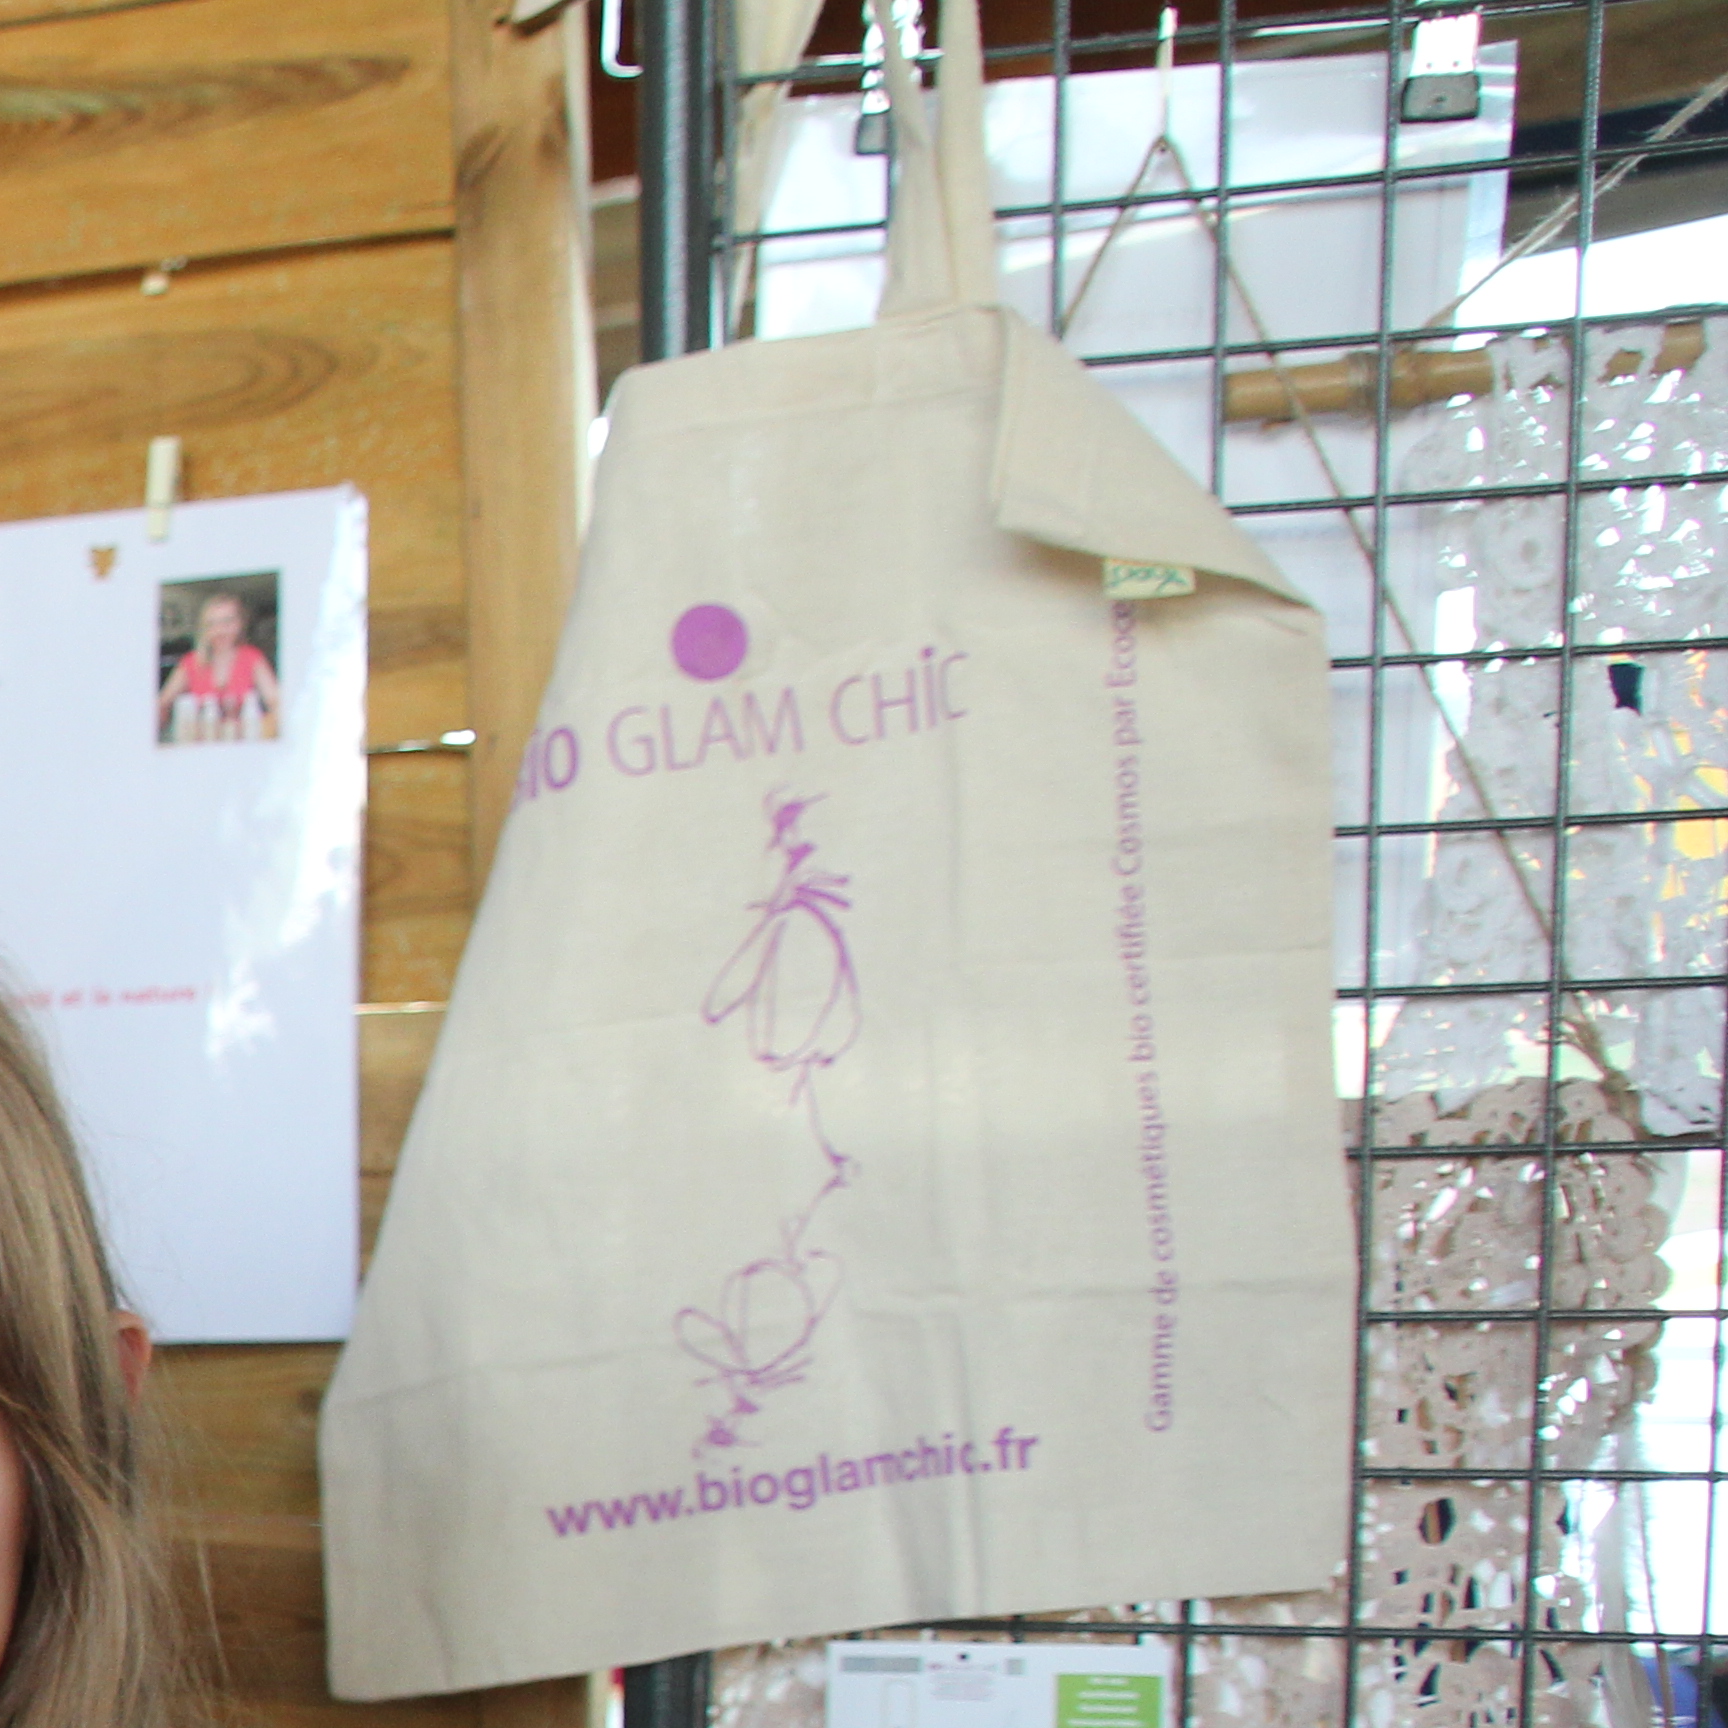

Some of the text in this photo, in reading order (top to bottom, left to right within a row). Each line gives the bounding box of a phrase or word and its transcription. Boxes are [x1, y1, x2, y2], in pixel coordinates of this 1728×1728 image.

[1104, 600, 1138, 688] Ecoce
[605, 686, 806, 777] GLAM
[1113, 697, 1144, 748] par
[1110, 755, 1144, 876] Cosmos
[1125, 1014, 1157, 1063] bio
[1147, 1267, 1179, 1306] de
[1145, 1311, 1177, 1433] Gamme
